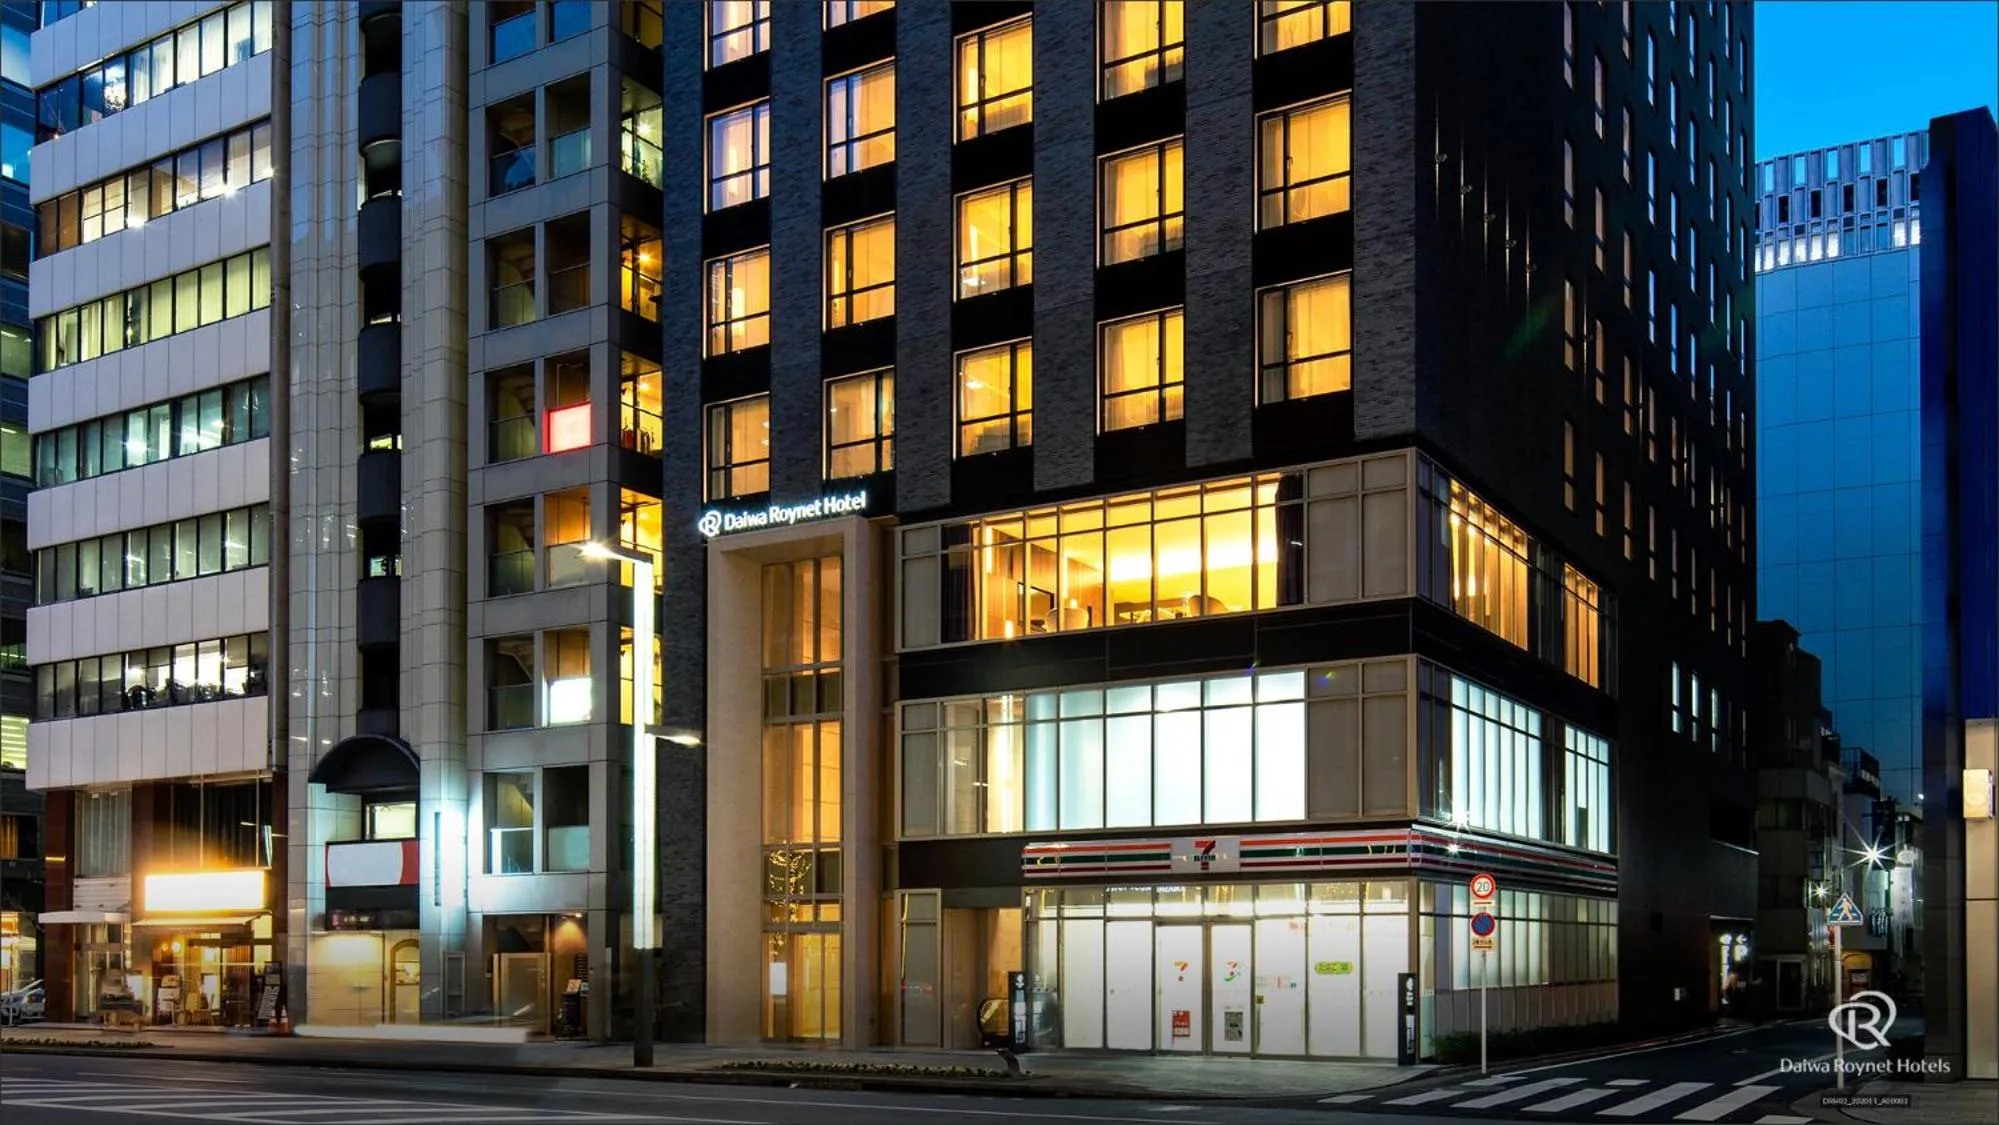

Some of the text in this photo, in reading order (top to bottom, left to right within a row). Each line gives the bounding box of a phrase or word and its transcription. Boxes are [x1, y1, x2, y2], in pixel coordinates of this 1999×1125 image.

[724, 490, 866, 531] Daiwa Roynet Hotel
[1476, 881, 1490, 893] 20
